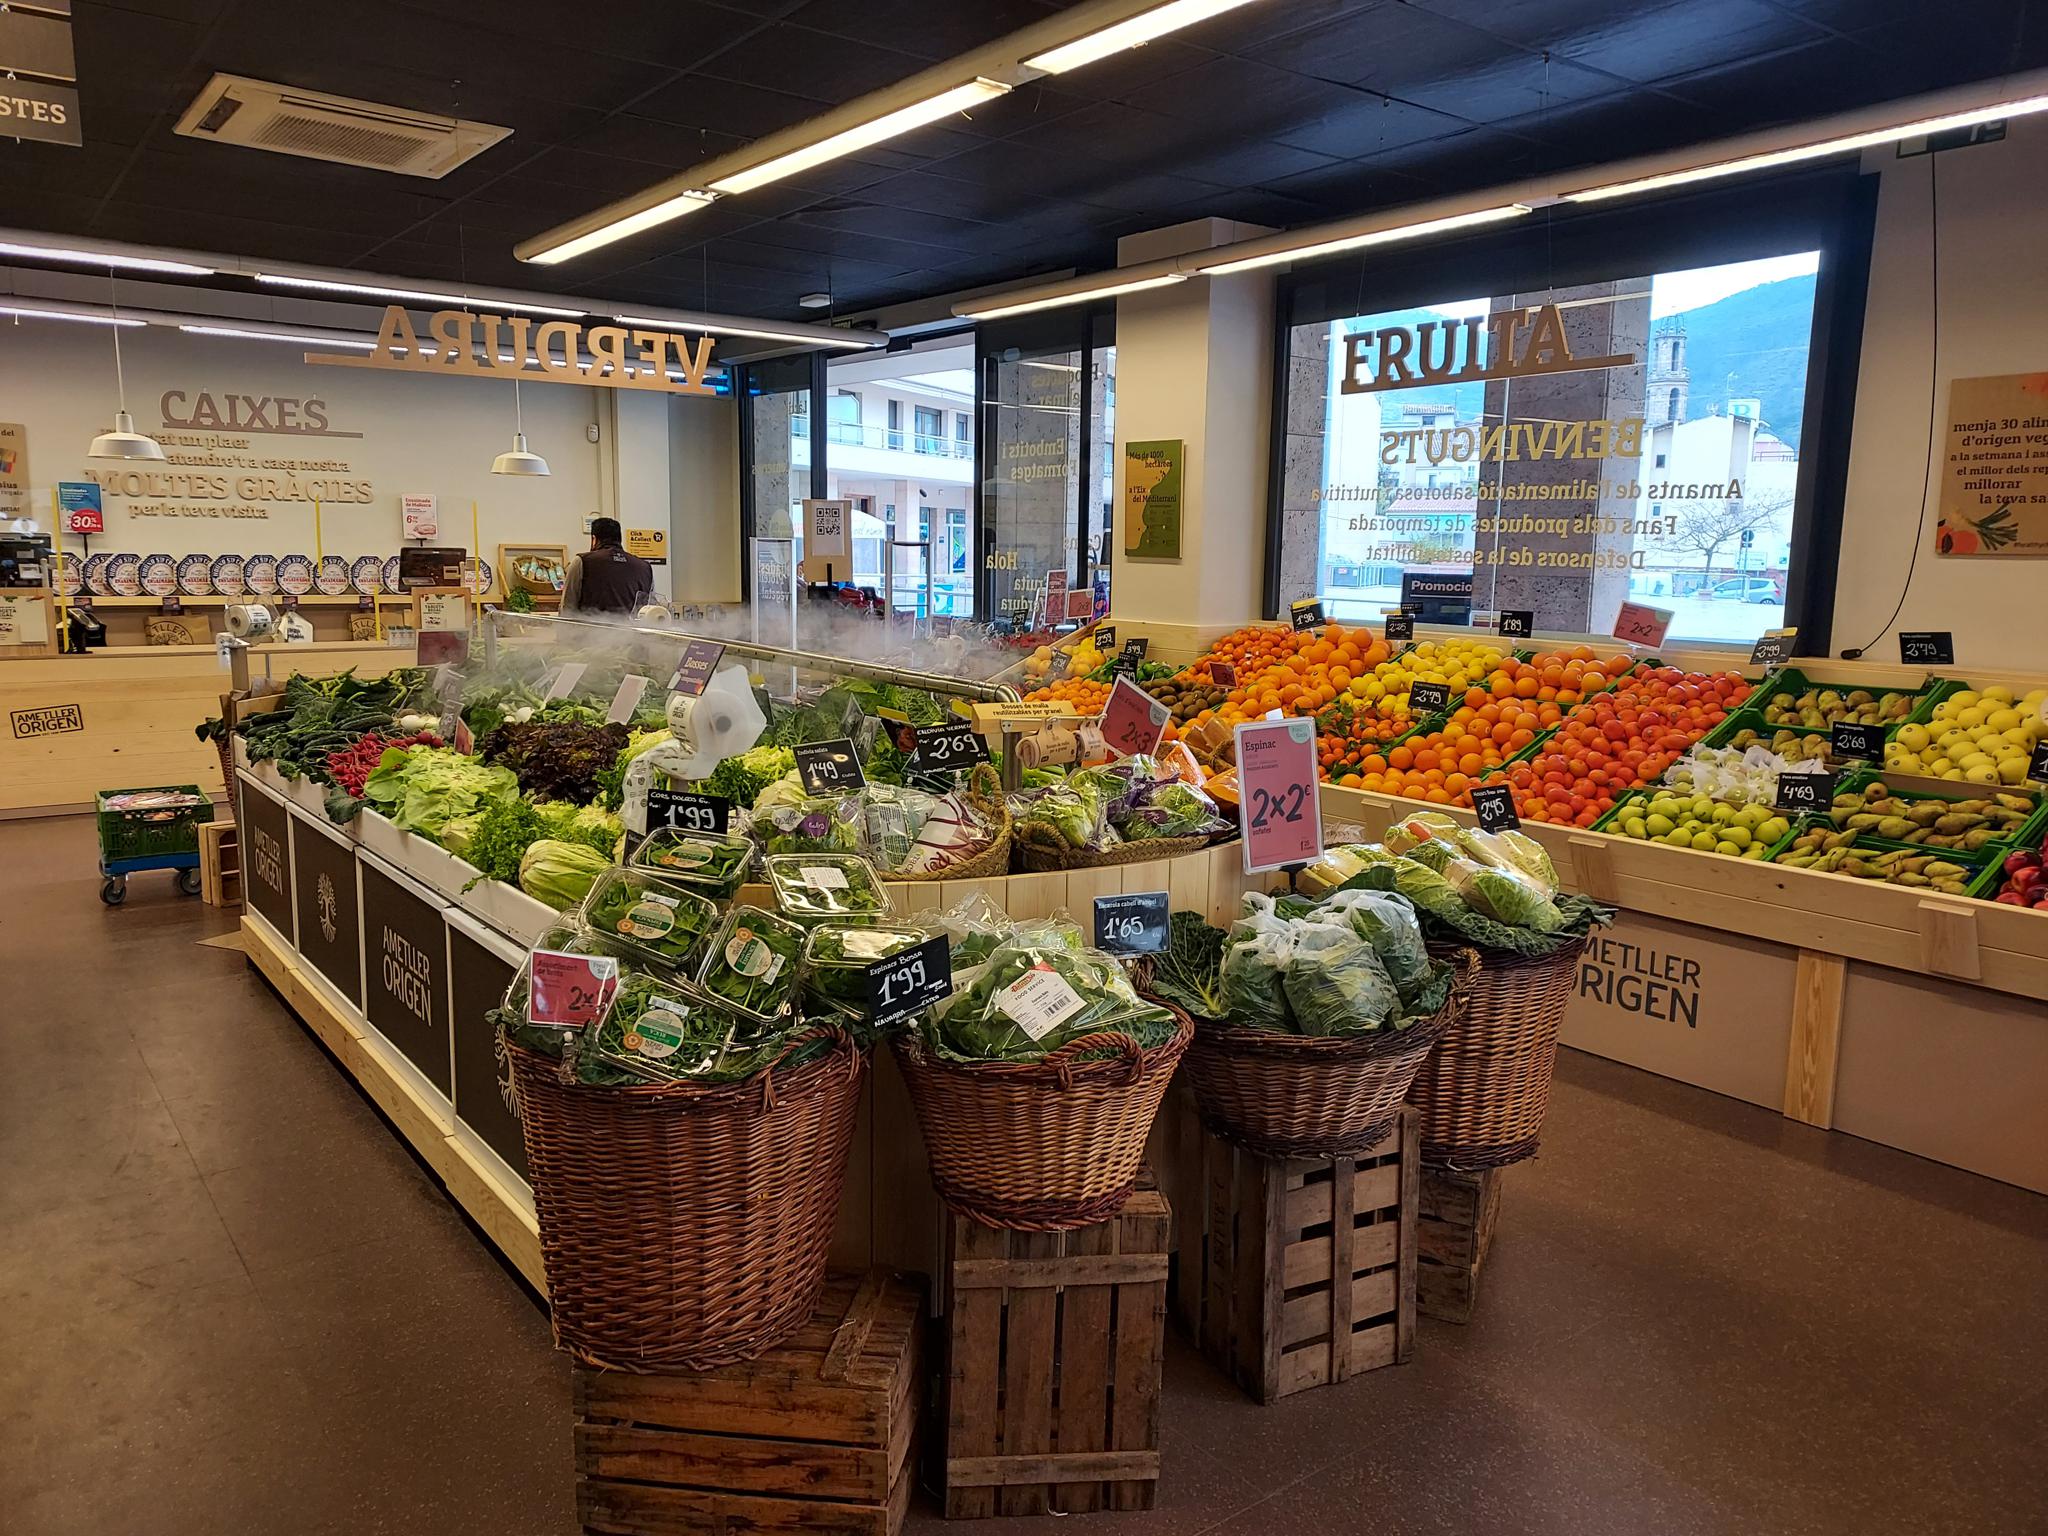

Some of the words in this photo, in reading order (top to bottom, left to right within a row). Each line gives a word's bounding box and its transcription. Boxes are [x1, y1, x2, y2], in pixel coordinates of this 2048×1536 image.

[1342, 304, 1574, 388] FRUITA
[160, 389, 329, 431] CAIXES
[1953, 420, 1997, 435] menja
[2001, 419, 2018, 429] 30
[206, 435, 251, 450] plaer
[1962, 434, 2022, 447] d'origen
[1951, 453, 1957, 461] a
[1959, 451, 1970, 461] la
[1972, 452, 2022, 461] setmana
[262, 459, 298, 471] casa
[300, 459, 351, 473] nostra
[1956, 466, 1966, 476] el
[1969, 465, 2003, 476] millor
[2006, 465, 2030, 474] dels
[84, 469, 230, 500] MOLTES
[236, 470, 375, 504] GRÀCIES
[1964, 479, 2023, 490] millorar
[1979, 493, 1992, 504] la
[1996, 494, 2027, 504] teva
[223, 504, 269, 519] visita
[1411, 580, 1472, 592] Promocio
[151, 622, 188, 639] TLLER
[1503, 618, 1522, 631] 1'89
[1905, 643, 1937, 656] 2'79
[1415, 689, 1442, 705] 2'79
[17, 708, 76, 723] AMETLLER
[18, 716, 78, 734] ORIGEN
[929, 733, 980, 760] 2'69
[1245, 740, 1276, 752] Espinac
[1836, 734, 1866, 749] 2'69
[806, 760, 839, 780] 1'49
[1783, 785, 1815, 801] 4'69
[664, 804, 716, 830] 1'99
[253, 825, 282, 865] AMETLLER
[254, 850, 283, 896] ORIGEN
[1103, 916, 1144, 940] 1'65
[383, 924, 432, 986] AMETLLER
[869, 960, 898, 976] Espinacs
[382, 954, 432, 1027] ORIGEN
[877, 959, 926, 1007] 1'99
[1572, 963, 1699, 1029] RIGEN
